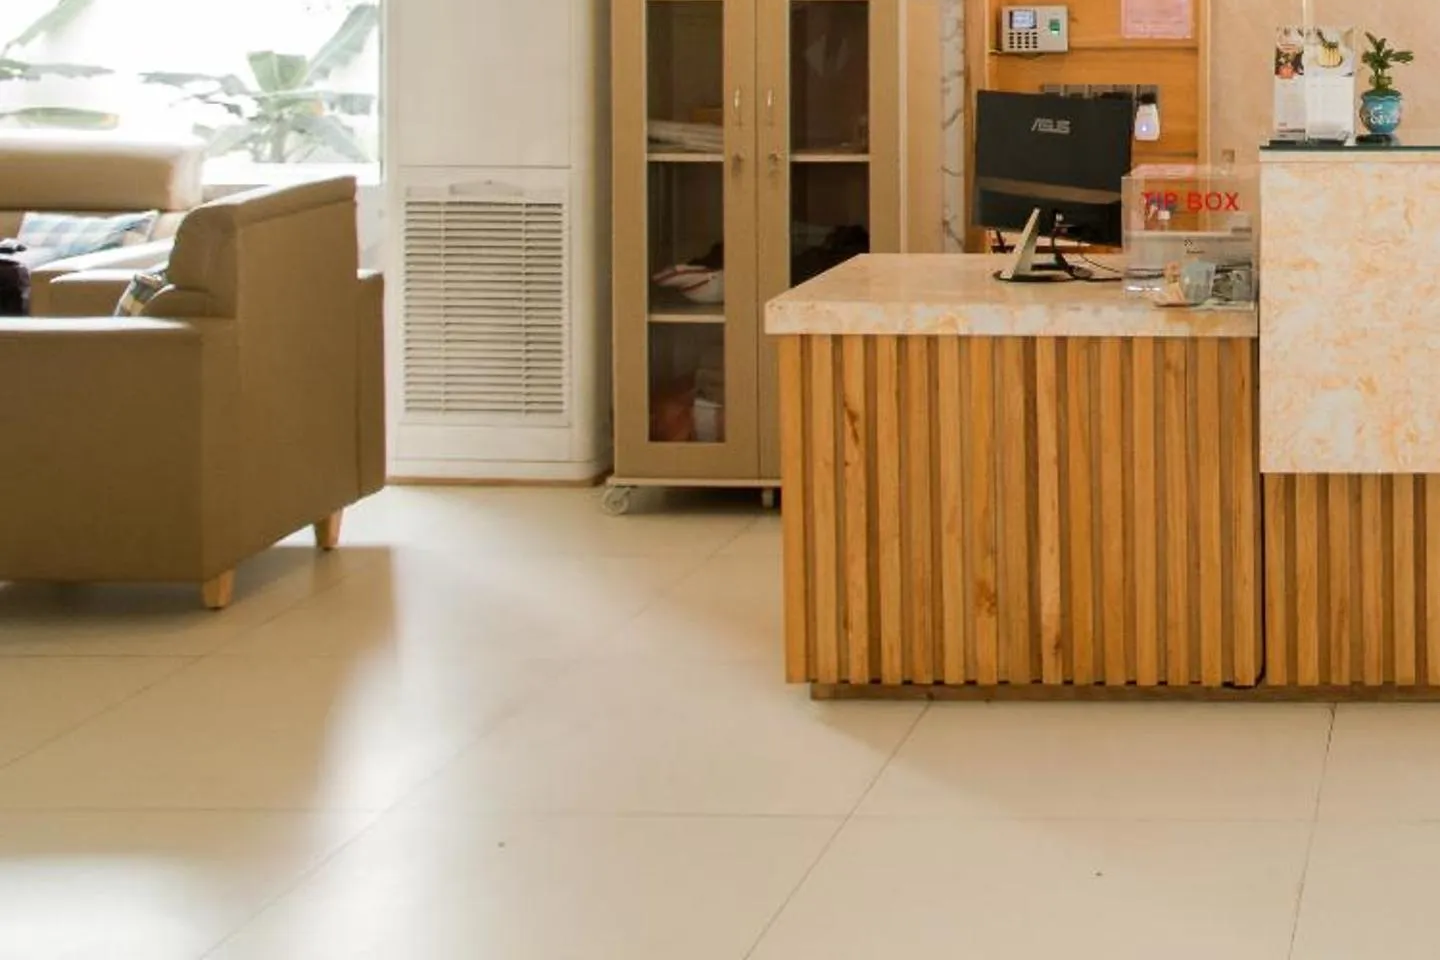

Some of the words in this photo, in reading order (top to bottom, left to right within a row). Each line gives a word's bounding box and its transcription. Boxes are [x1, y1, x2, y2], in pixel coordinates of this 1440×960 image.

[1031, 118, 1070, 134] ASUS
[1142, 192, 1177, 211] TIP
[1187, 191, 1239, 211] BOX
